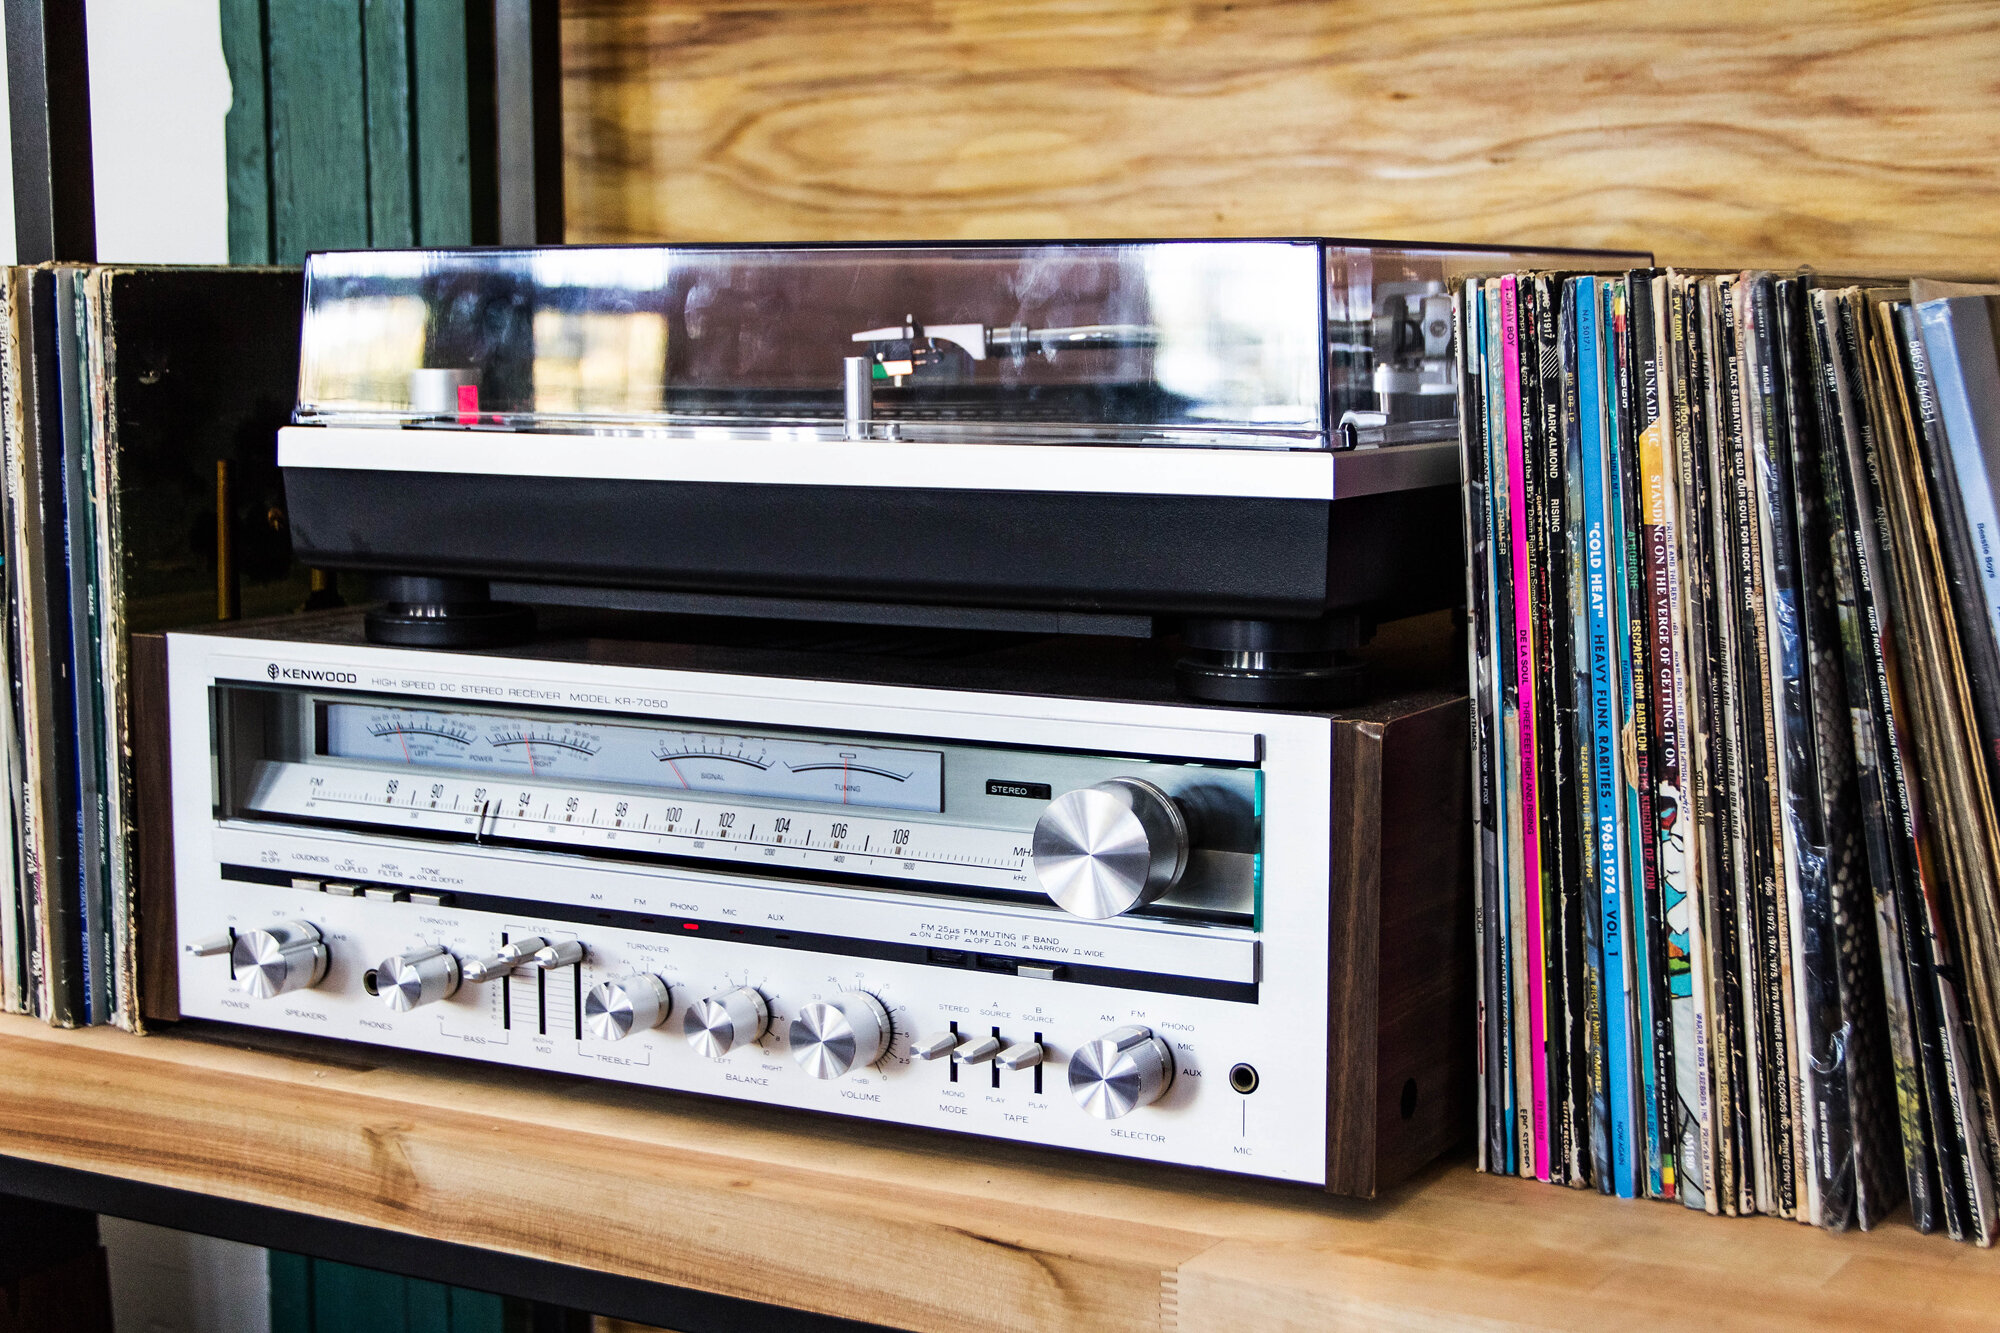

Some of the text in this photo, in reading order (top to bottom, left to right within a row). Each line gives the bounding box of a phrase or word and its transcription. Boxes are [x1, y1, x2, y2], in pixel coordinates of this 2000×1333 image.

[1504, 286, 1516, 346] TOMMY BOY
[1582, 310, 1588, 324] NA
[1725, 306, 1734, 328] 2923
[1544, 311, 1552, 339] 31917
[1762, 365, 1770, 394] MADLIB
[1909, 340, 1936, 424] 88697-84493-1
[1644, 360, 1658, 446] FUNKADELIC
[1678, 379, 1692, 486] BILLY IDOL STOP
[1547, 404, 1560, 532] MARK-ALMOND RISING
[1728, 356, 1752, 610] BLACK SABBATH/WE SOLD OUR SOUL FOR ROCK ROLL
[1497, 508, 1506, 556] THRILLER
[1589, 522, 1602, 568] "COLD
[1977, 523, 1996, 578] Beastie Boys
[1530, 562, 1538, 575] Am
[1592, 573, 1604, 618] HEAT"
[1650, 475, 1676, 767] STANDING ON THE VERGE OF GETTING IT ON
[1520, 630, 1530, 686] DE LA SOUL
[1595, 634, 1606, 684] HEAVY
[283, 668, 356, 684] KENWOOD
[1854, 530, 1913, 838] KRUSH GROOVE MUSIC FROM THE ORIGINAL PICTURE SOUND TRACK
[372, 678, 668, 709] HIGH SPEED DC STEREO RECEIVER MODEL KR-7050
[1522, 702, 1530, 730] THREE
[1596, 690, 1608, 730] FUNK
[1524, 732, 1532, 756] FEET
[1632, 620, 1656, 890] ESCPAPE FROM BABYLON TO KINGDOM OF ZION
[1726, 737, 1734, 767] JUNIOR
[1598, 736, 1611, 798] RARITIES
[834, 784, 861, 793] TUNING
[1696, 770, 1704, 795] SOUL
[991, 786, 1027, 796] STEREO
[386, 780, 910, 845] 88 90 92 94 96 98 100 102 104 106 108
[1526, 804, 1535, 836] RISING
[292, 853, 330, 864] LOUDNESS
[1600, 816, 1616, 895] 1968-1974
[334, 864, 368, 874] COUPLED
[378, 869, 403, 878] FILTER
[420, 867, 440, 876] TONE
[438, 876, 464, 886] DEFEAT
[670, 902, 698, 912] PHONO
[722, 908, 737, 916] MIC
[419, 916, 459, 927] TURNOVER
[768, 914, 784, 922] AUX
[921, 924, 935, 932] FM
[1606, 910, 1618, 944] VOL.
[980, 930, 1016, 940] MUTING
[1034, 936, 1060, 946] BAND
[626, 942, 670, 953] TURNOVER
[1032, 944, 1068, 954] NARROW
[221, 1000, 250, 1009] POWER
[938, 1004, 970, 1014] STEREO
[285, 1009, 328, 1021] SPEAKERS
[980, 1008, 1012, 1019] SOURCE
[1022, 1014, 1055, 1024] SOURCE
[360, 1020, 392, 1030] PHONES
[1161, 1022, 1195, 1032] PHONO
[464, 1035, 486, 1044] BASS
[536, 1046, 552, 1054] MID
[1178, 1042, 1194, 1051] MIC
[596, 1054, 632, 1066] TREBLE
[762, 1064, 783, 1072] RIGHT
[1182, 1068, 1202, 1077] AUX
[726, 1073, 769, 1087] BALANCE
[1772, 1002, 1791, 1172] WARNER RECORDS PRINTED
[840, 1090, 882, 1102] VOLUME
[942, 1089, 966, 1098] MONO
[986, 1096, 1005, 1104] PLAY
[1028, 1101, 1048, 1110] PLAY
[940, 1104, 968, 1115] MODE
[1004, 1114, 1029, 1124] TAPE
[1110, 1128, 1166, 1143] SELECTOR
[1234, 1146, 1252, 1156] MIC
